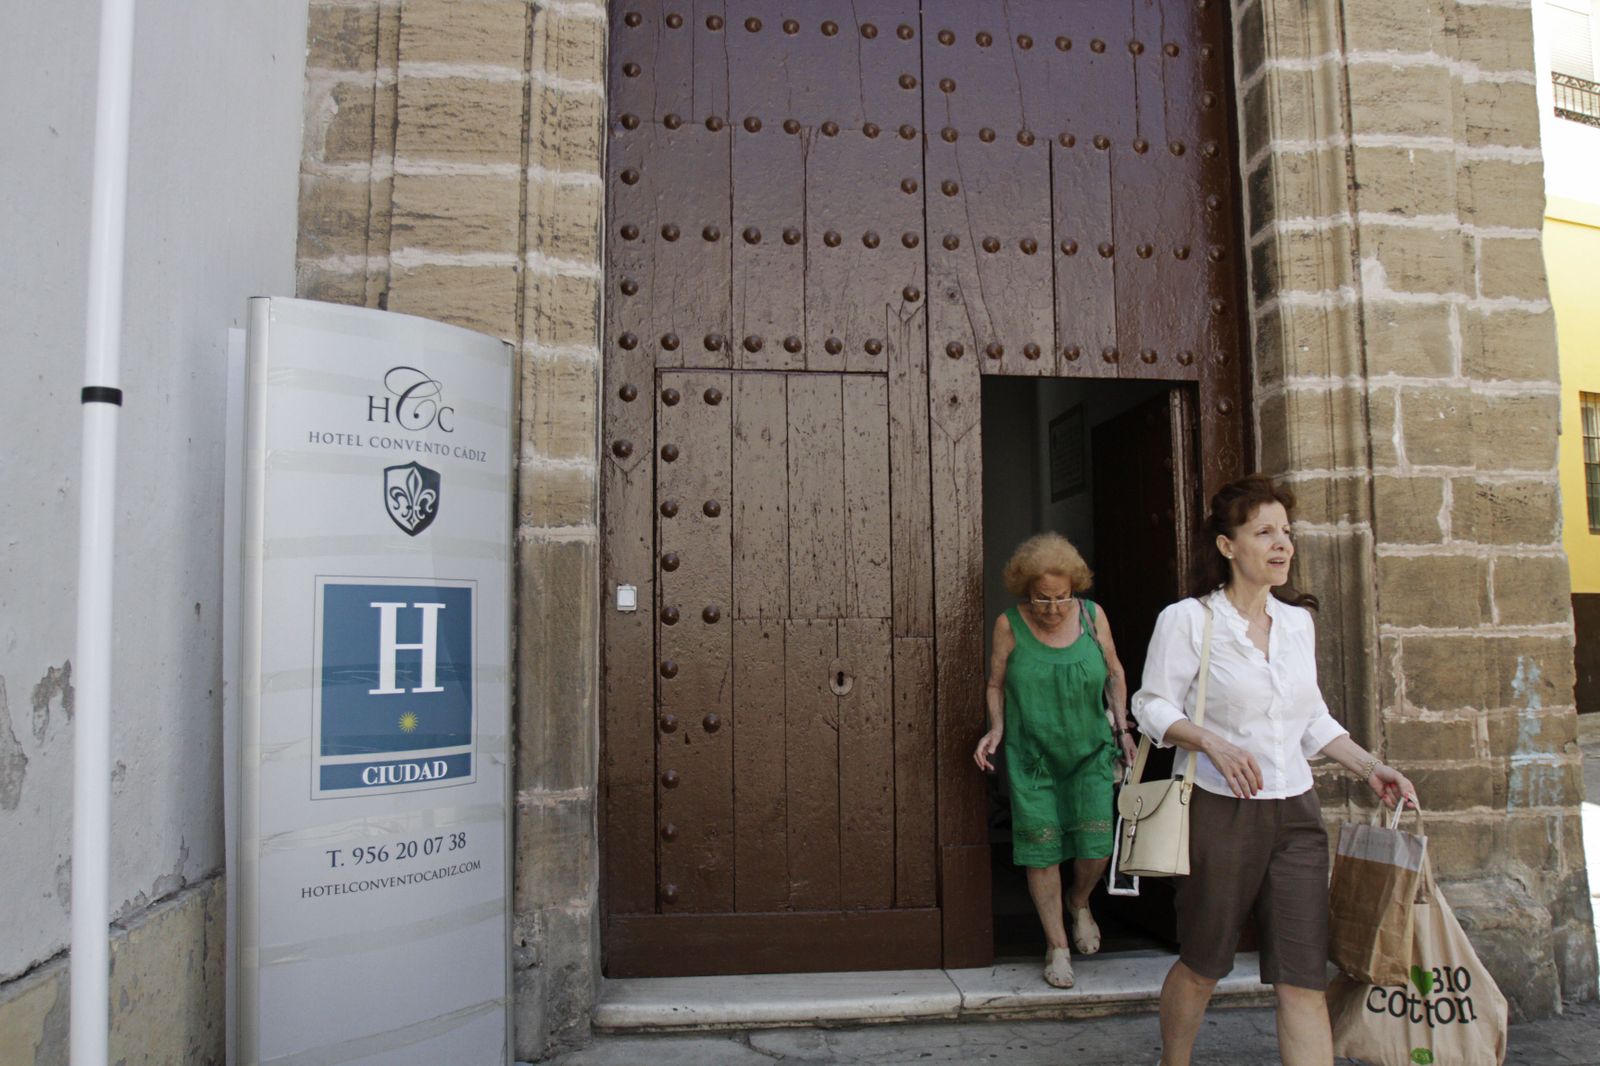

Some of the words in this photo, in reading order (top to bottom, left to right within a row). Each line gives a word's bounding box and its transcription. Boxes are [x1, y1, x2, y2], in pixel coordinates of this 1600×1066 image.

[308, 431, 364, 447] HOTEL
[369, 436, 450, 456] CONVENTO
[453, 446, 487, 463] CÁDIZ
[368, 601, 446, 695] H
[361, 760, 448, 786] CIUDAD
[326, 849, 345, 868] T.
[352, 841, 389, 866] 956
[395, 838, 418, 861] 20
[423, 836, 444, 857] 07
[448, 831, 467, 851] 38
[300, 859, 482, 899] HOTELCONVENTOCADIZ.COM
